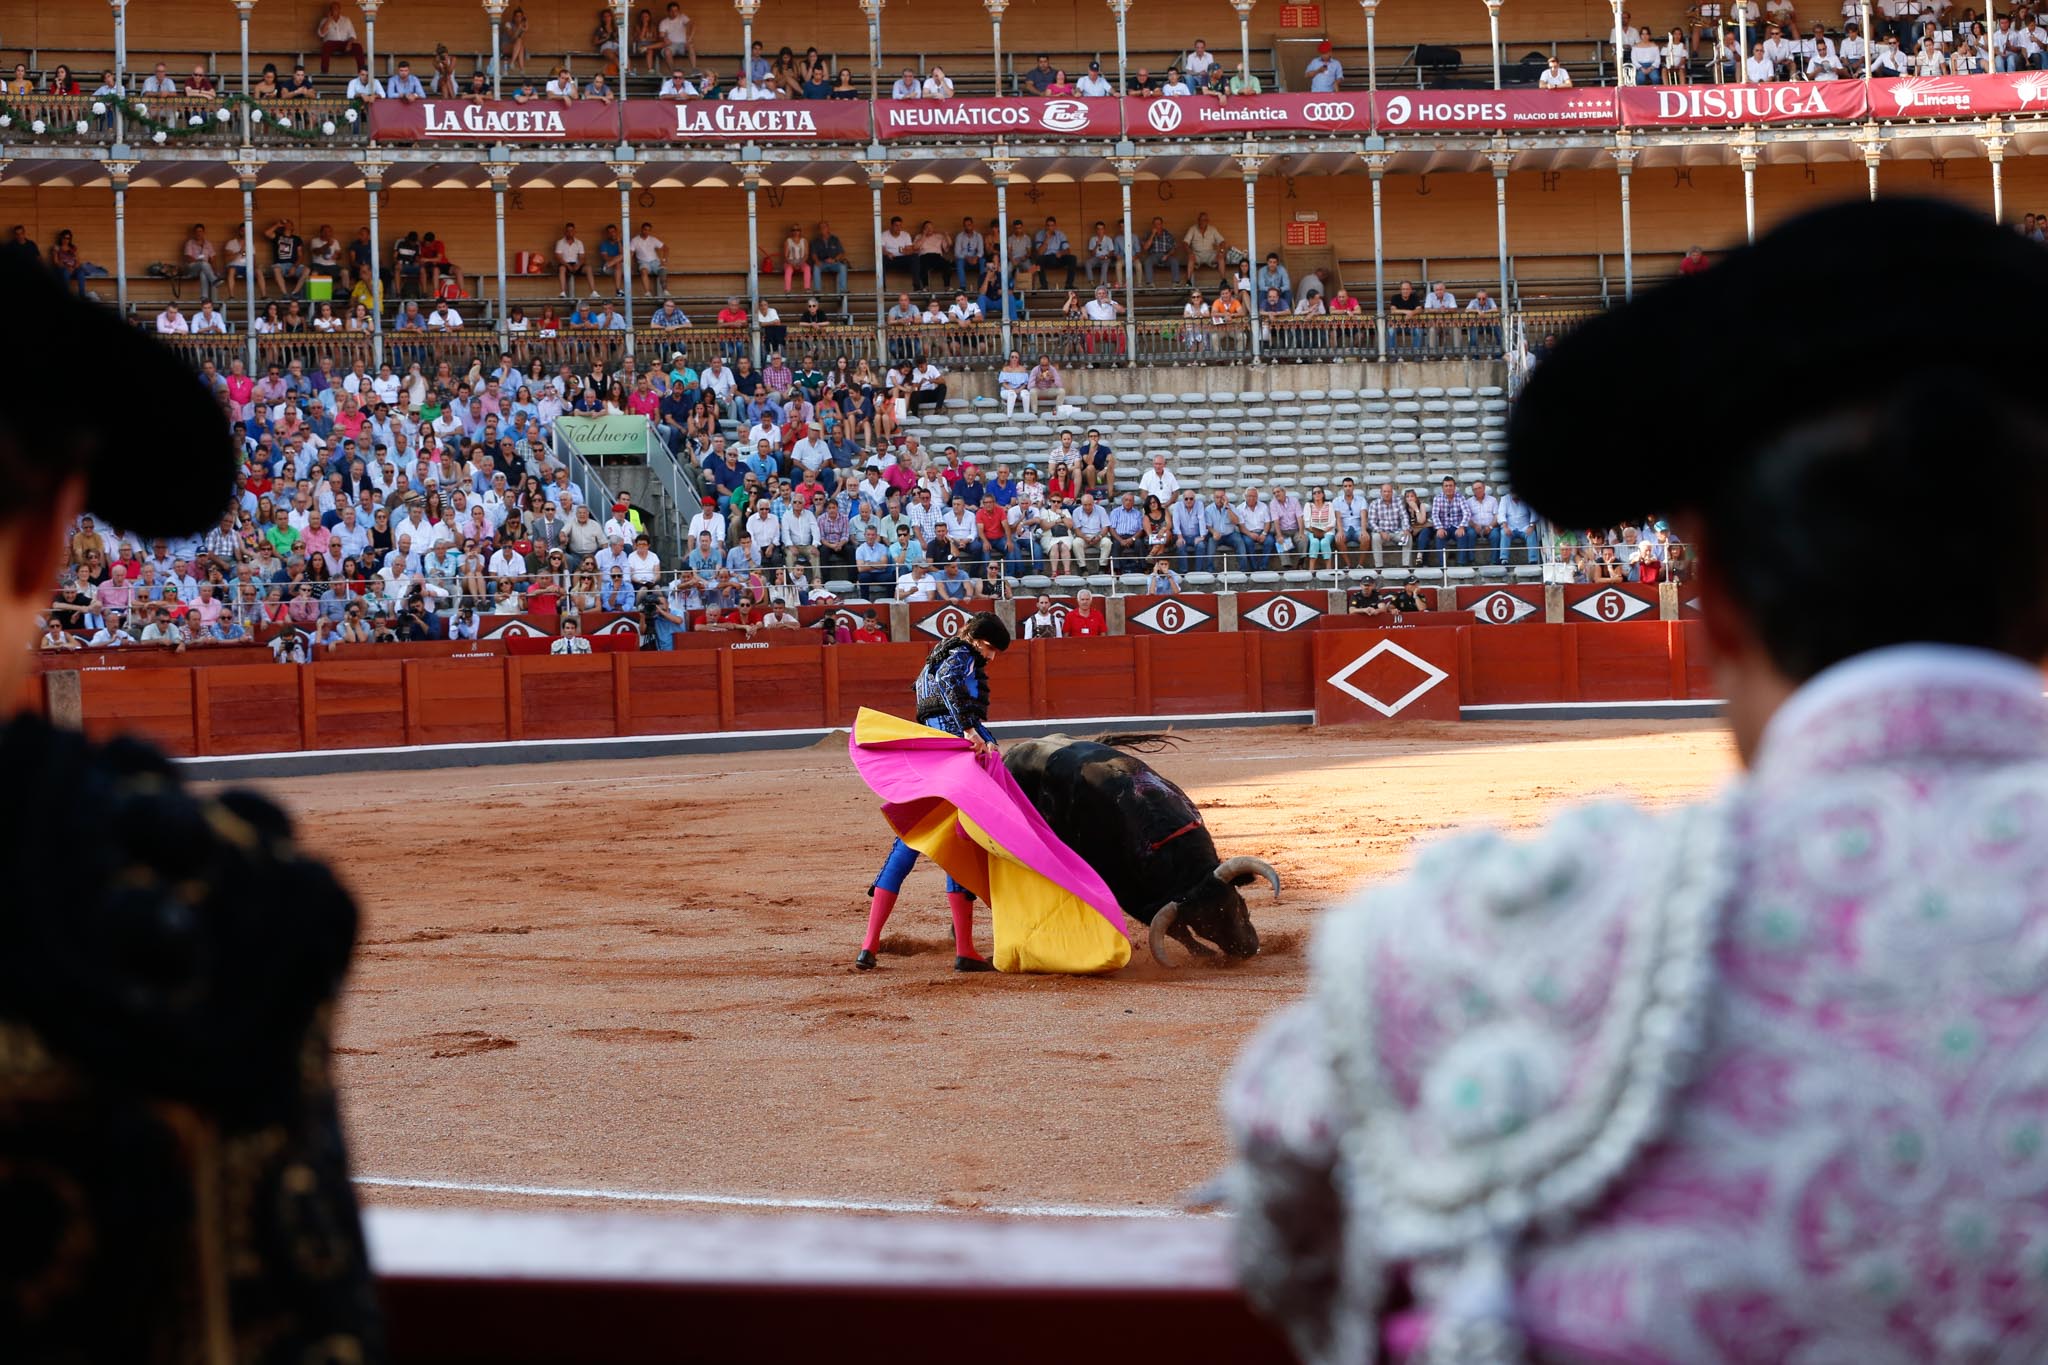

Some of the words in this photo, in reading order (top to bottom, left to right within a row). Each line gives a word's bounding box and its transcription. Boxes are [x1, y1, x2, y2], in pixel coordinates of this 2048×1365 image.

[1656, 85, 1831, 119] DISJUGA
[1914, 92, 1971, 106] Limcasa
[889, 103, 1031, 126] NEUMÁTICOS
[1199, 106, 1288, 121] Helmántica
[1418, 103, 1507, 121] HOSPES
[1513, 113, 1547, 121] PALACIO
[1548, 112, 1559, 120] DE
[1561, 111, 1577, 120] SAN
[1579, 111, 1613, 119] ESTEBAN
[565, 424, 639, 443] Valduero
[1162, 606, 1178, 629] 6
[1273, 603, 1289, 626] 6
[1492, 598, 1508, 620] 6
[1604, 596, 1619, 619] 5
[942, 612, 958, 636] 6
[731, 642, 769, 650] CARPINTERO
